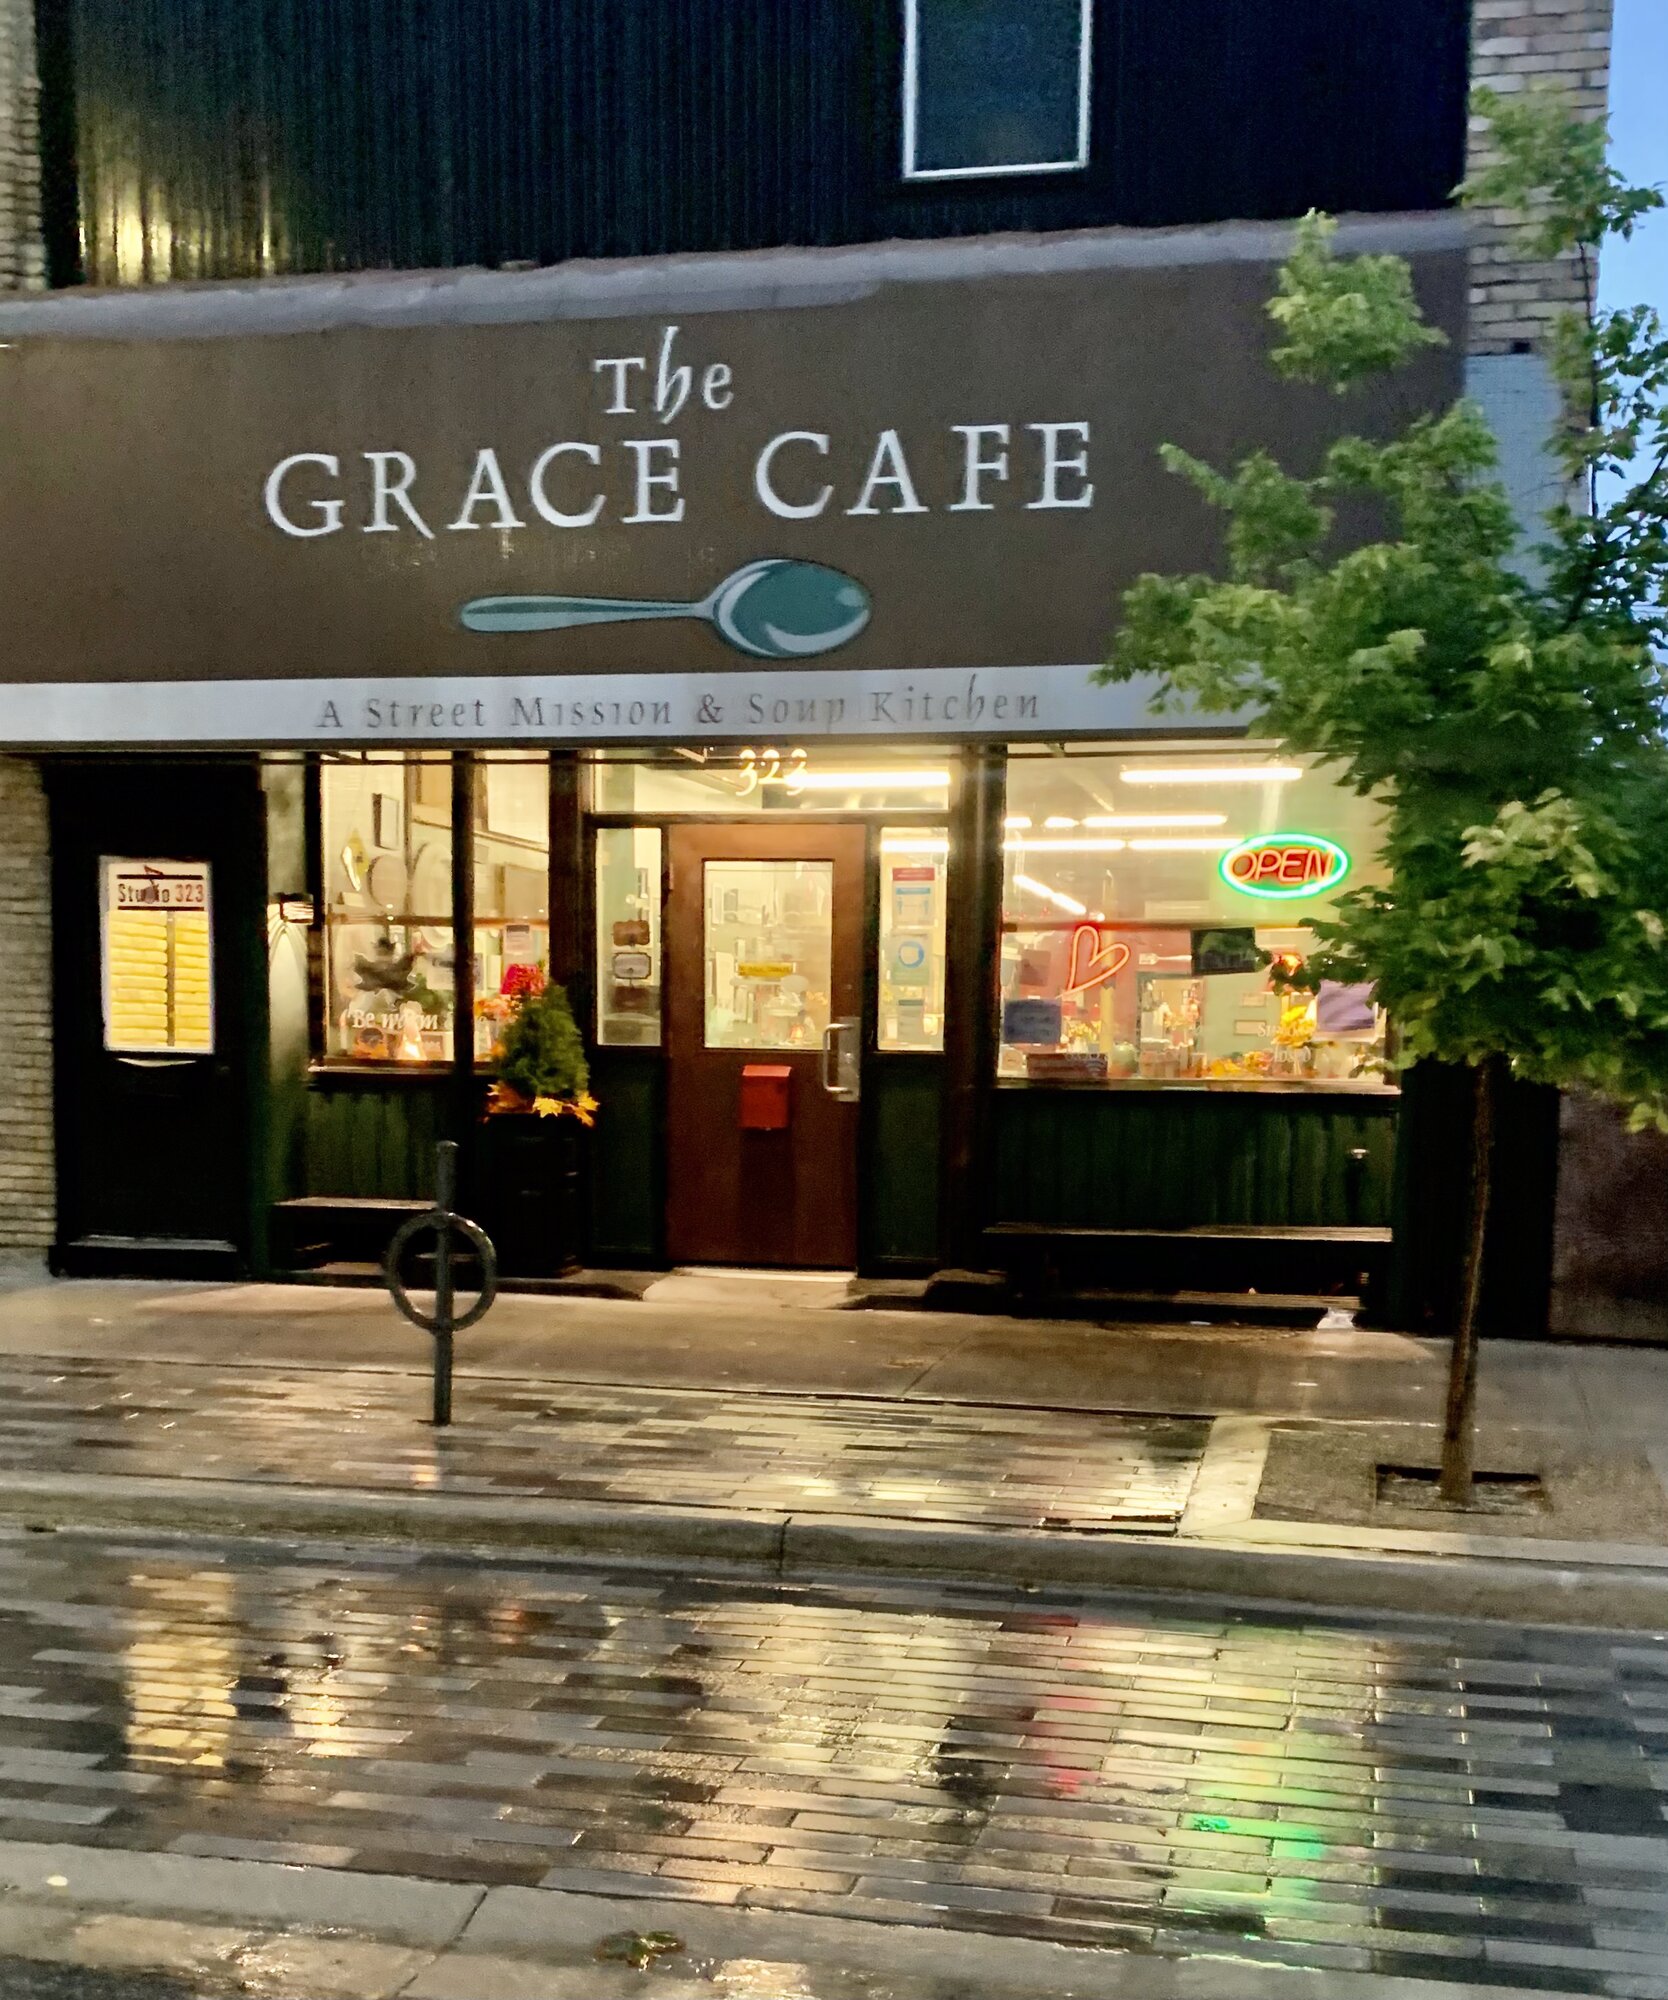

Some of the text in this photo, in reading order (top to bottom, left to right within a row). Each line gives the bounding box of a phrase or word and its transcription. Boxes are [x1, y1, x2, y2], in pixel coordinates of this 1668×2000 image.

[593, 325, 735, 425] The
[264, 421, 1095, 540] GRACE CAFE
[317, 673, 1040, 733] A Street Mission & Soup Kitchen
[735, 747, 808, 796] 323
[1230, 848, 1334, 883] OPEN
[175, 884, 204, 902] 323
